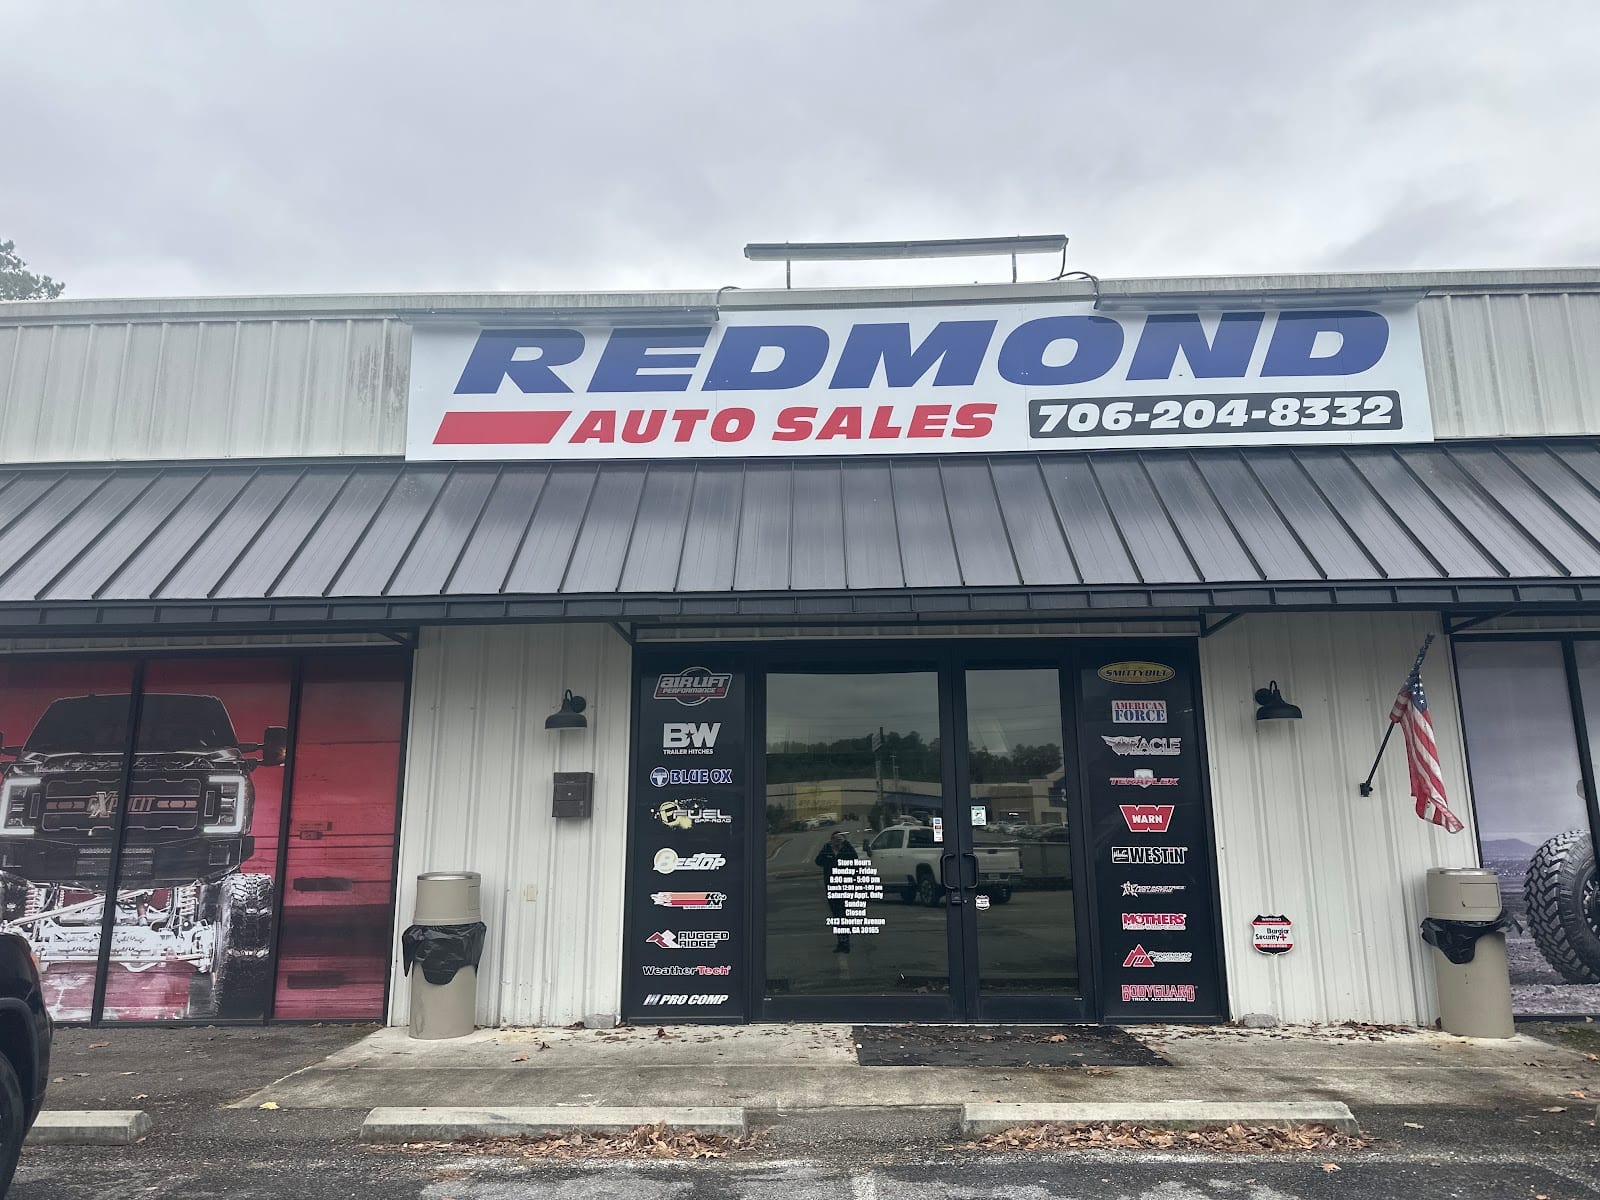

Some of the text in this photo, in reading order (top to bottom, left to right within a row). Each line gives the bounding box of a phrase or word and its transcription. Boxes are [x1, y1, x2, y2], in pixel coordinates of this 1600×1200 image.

[453, 310, 1390, 394] REDMOND
[1037, 397, 1394, 433] 706-204-8332
[568, 403, 998, 444] AUTO SALES
[1114, 702, 1165, 710] AMERICAN
[1115, 709, 1165, 722] FORCE
[670, 769, 733, 784] BLUE OX
[87, 791, 156, 818] EXPICIT
[1132, 814, 1163, 824] WARN
[832, 867, 855, 875] Monday
[859, 867, 877, 875] Friday
[827, 891, 854, 899] Saturday
[870, 891, 883, 899] Only
[844, 900, 867, 908] Sunday
[1122, 913, 1184, 925] MOTHERS
[678, 931, 729, 940] RUGGED
[678, 940, 716, 948] RIDGE
[1121, 984, 1195, 1002] BODYGUARD
[660, 995, 728, 1005] PRO COMP
